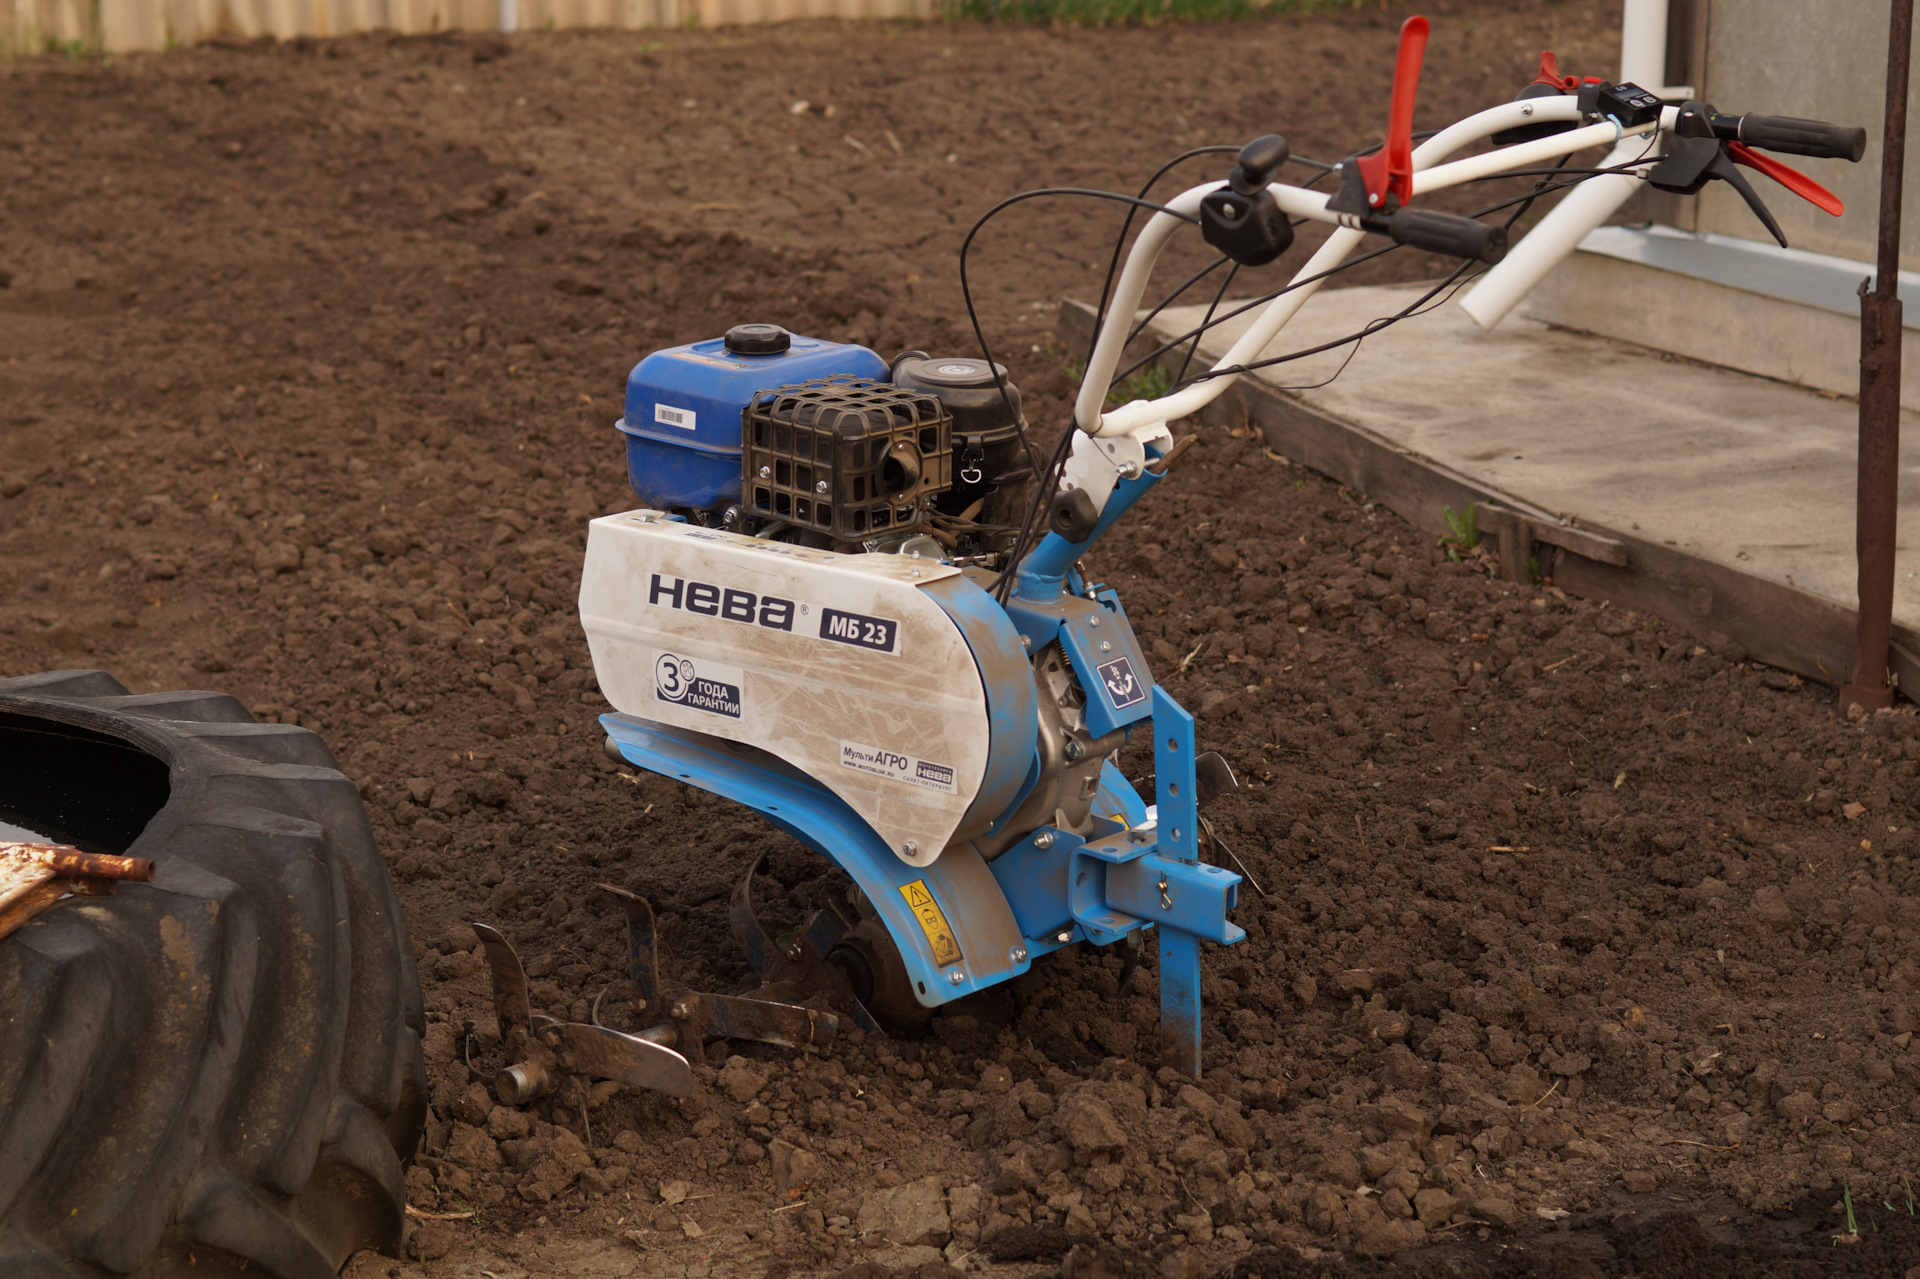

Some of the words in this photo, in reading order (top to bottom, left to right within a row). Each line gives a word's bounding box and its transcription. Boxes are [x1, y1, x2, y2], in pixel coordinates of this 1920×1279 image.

[828, 615, 860, 640] МБ
[862, 622, 887, 646] 23
[663, 662, 679, 692] 3
[698, 681, 729, 699] ГОДА
[687, 692, 740, 715] ГАРАНТИИ
[843, 746, 874, 762] Мульти
[874, 751, 908, 771] АГРО
[902, 775, 953, 792] САНКТ-ПЕТЕРБУРГ
